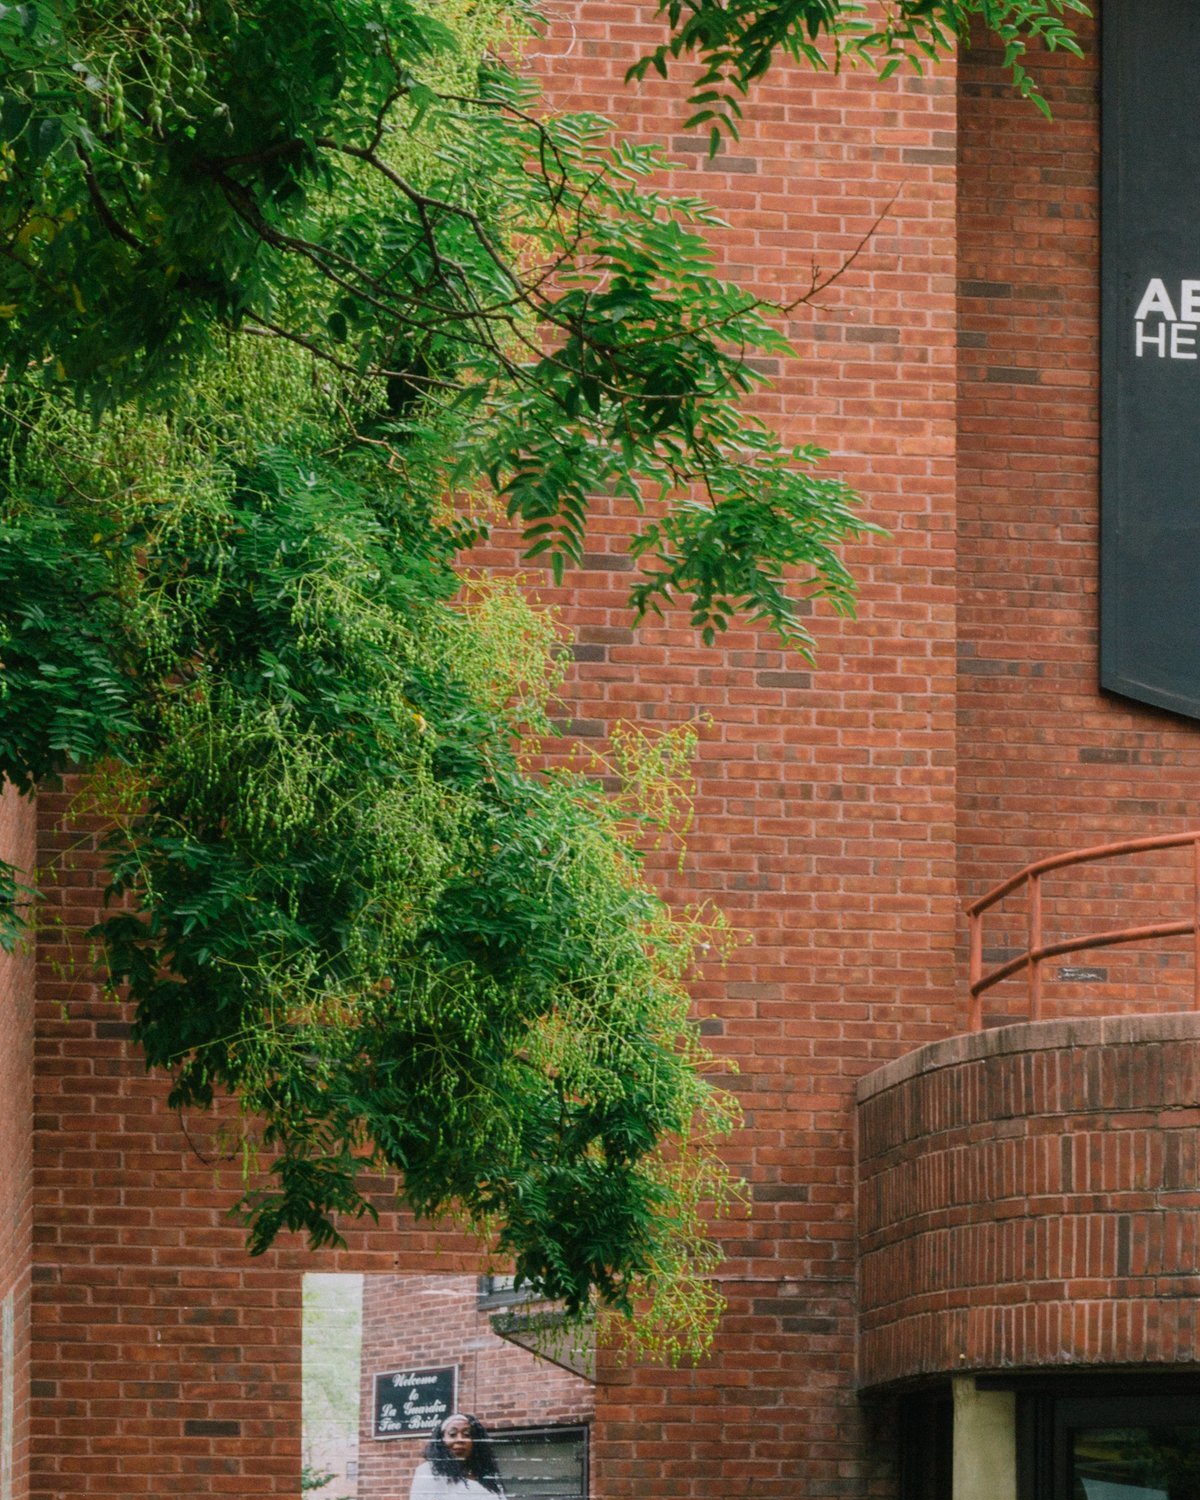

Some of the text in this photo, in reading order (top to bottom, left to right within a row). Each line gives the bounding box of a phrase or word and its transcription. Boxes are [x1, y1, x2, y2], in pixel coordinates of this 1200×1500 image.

[392, 1372, 438, 1387] Welcome
[408, 1388, 419, 1401] to
[381, 1399, 447, 1417] La Guardia
[378, 1417, 401, 1431] Two
